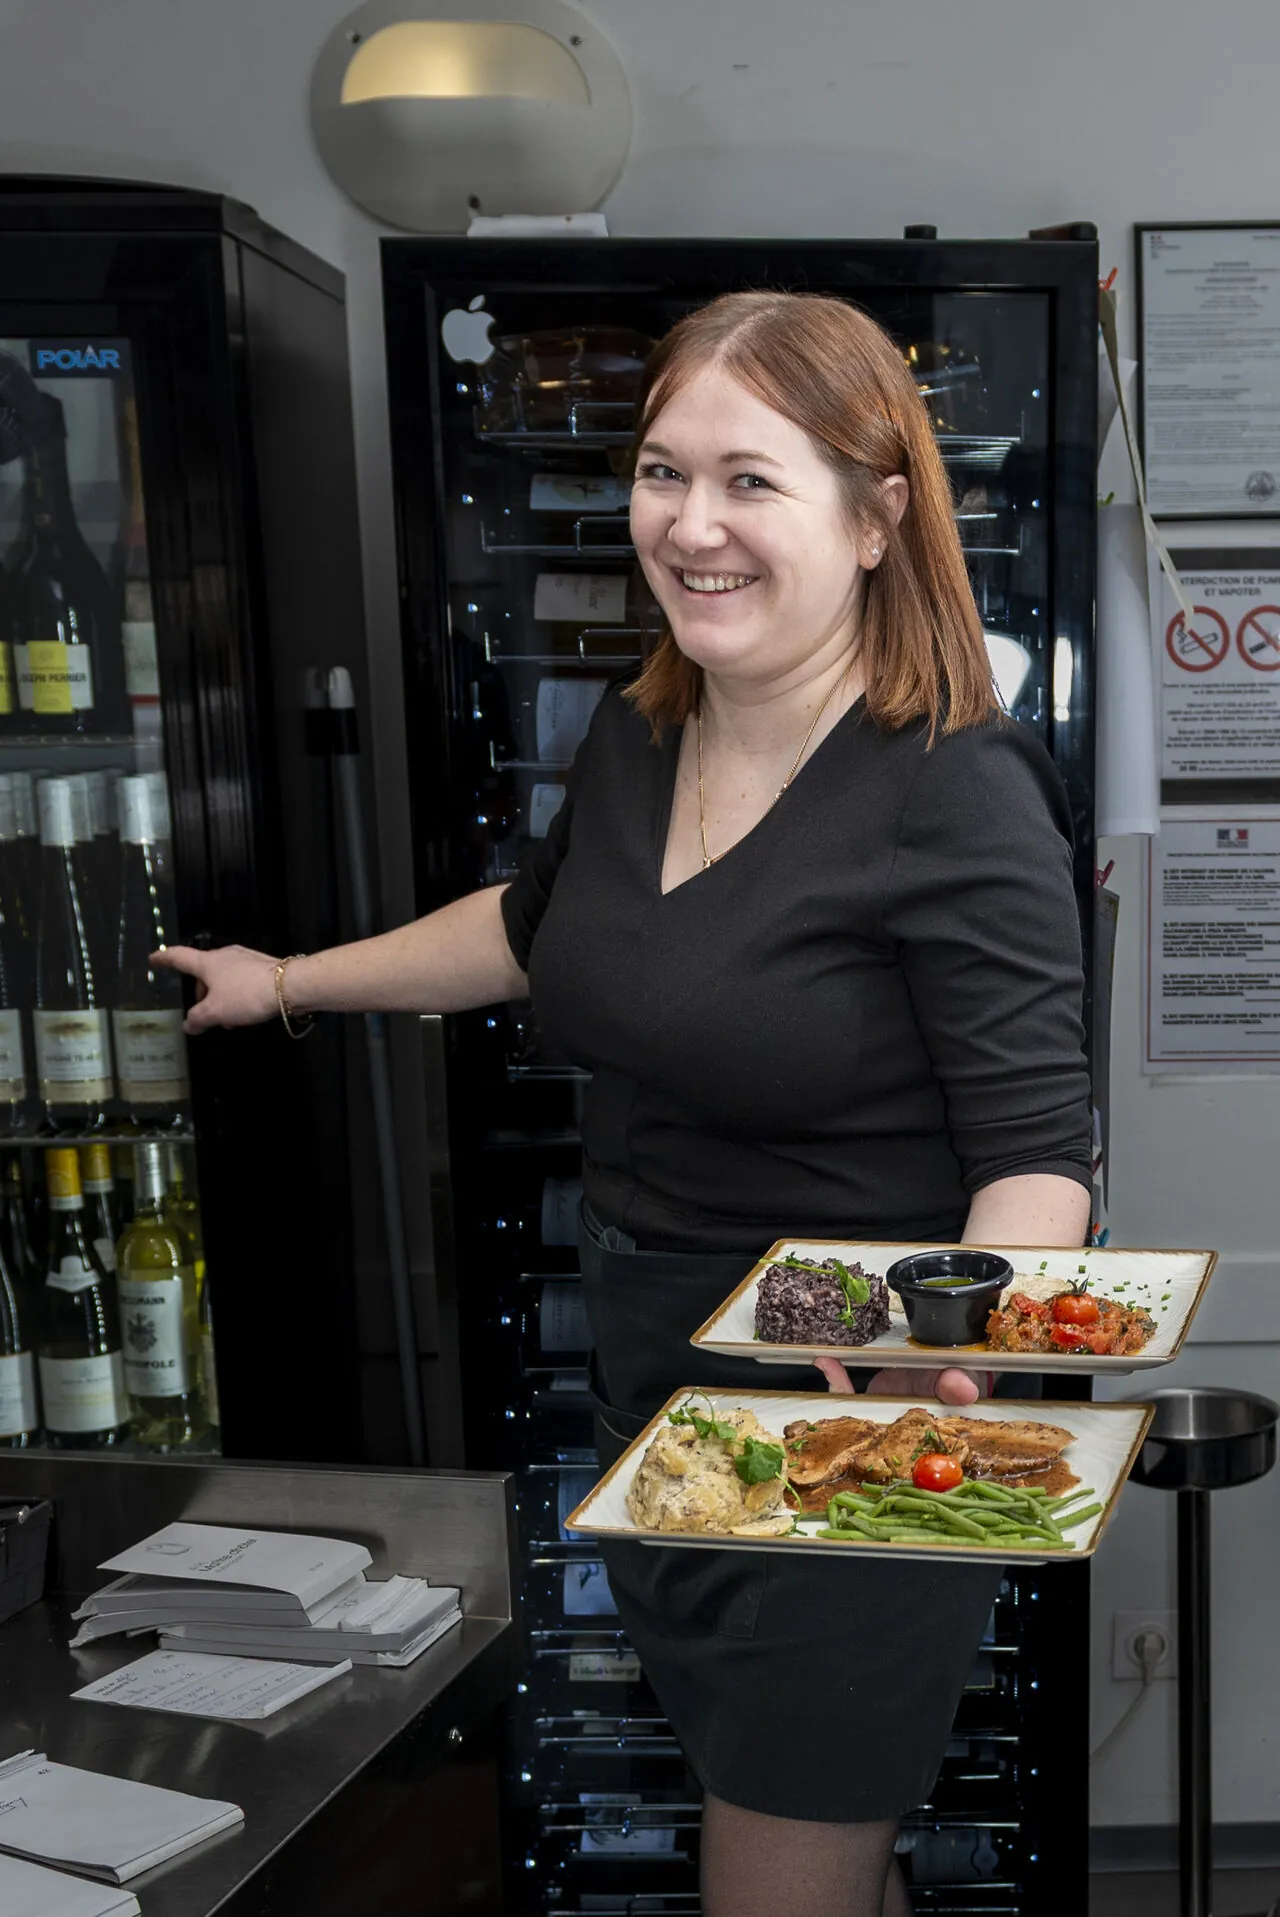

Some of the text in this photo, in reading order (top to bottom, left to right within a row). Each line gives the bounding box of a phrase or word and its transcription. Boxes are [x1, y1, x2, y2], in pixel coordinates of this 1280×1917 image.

[36, 344, 121, 370] POLAR
[1242, 576, 1256, 584] DE
[1204, 587, 1261, 597] ET VAPOTER
